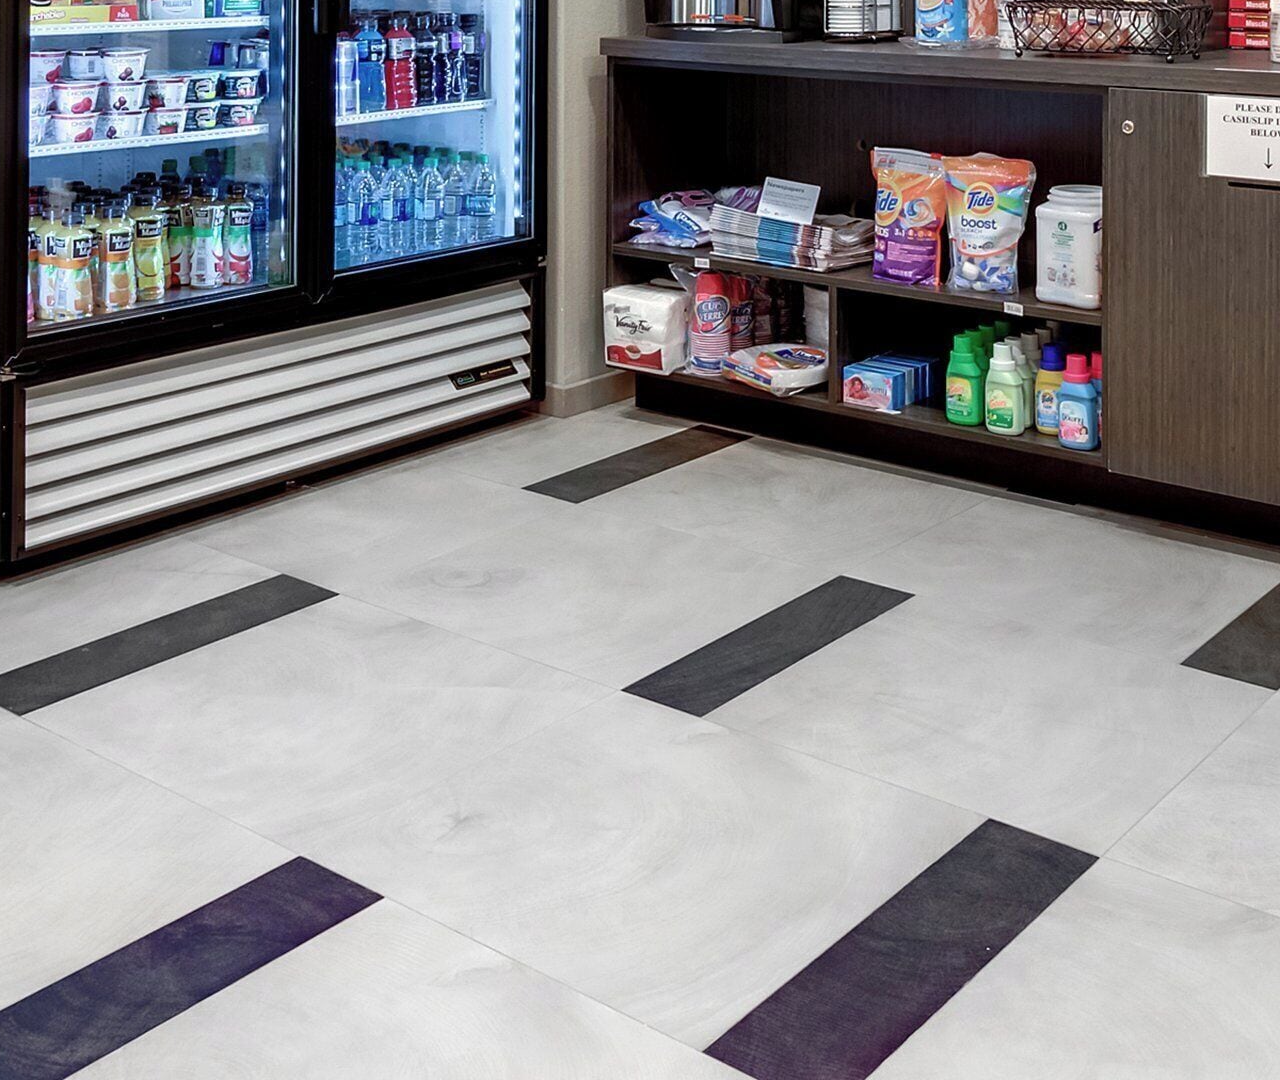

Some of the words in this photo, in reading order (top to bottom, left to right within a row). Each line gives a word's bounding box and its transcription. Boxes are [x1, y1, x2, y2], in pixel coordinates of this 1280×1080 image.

[1246, 1, 1268, 9] Muscle
[1246, 19, 1268, 27] Muscle
[1246, 38, 1268, 46] Muscle
[1235, 104, 1272, 113] PLEASE
[1223, 115, 1274, 125] CASH/SLIP
[767, 181, 805, 193] Newspapers
[877, 190, 898, 212] ide
[966, 191, 995, 209] Tide
[960, 216, 997, 230] boost
[615, 315, 638, 334] Vanity
[637, 320, 652, 333] Fair
